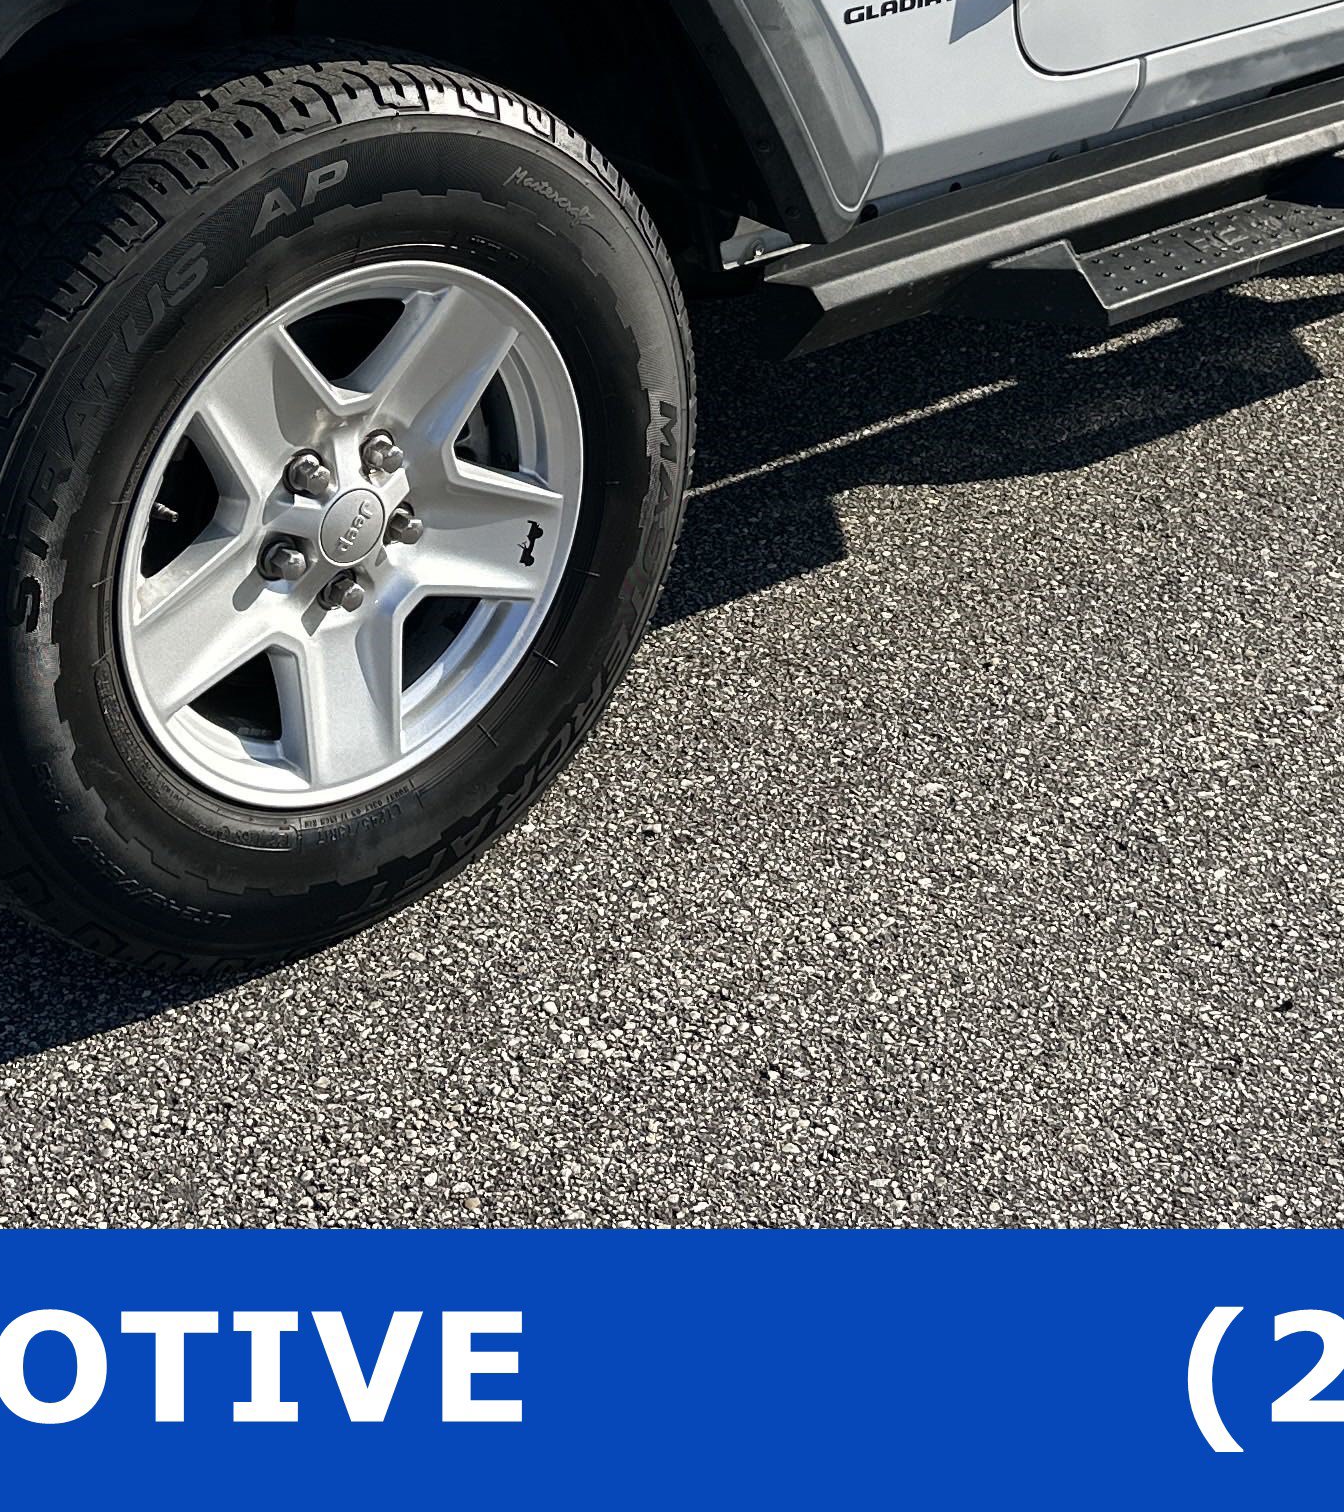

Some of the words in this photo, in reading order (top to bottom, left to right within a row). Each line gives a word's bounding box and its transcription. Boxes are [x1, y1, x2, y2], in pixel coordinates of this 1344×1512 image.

[249, 159, 350, 239] AP
[7, 241, 212, 633] STRATUS
[335, 498, 374, 553] Jeep
